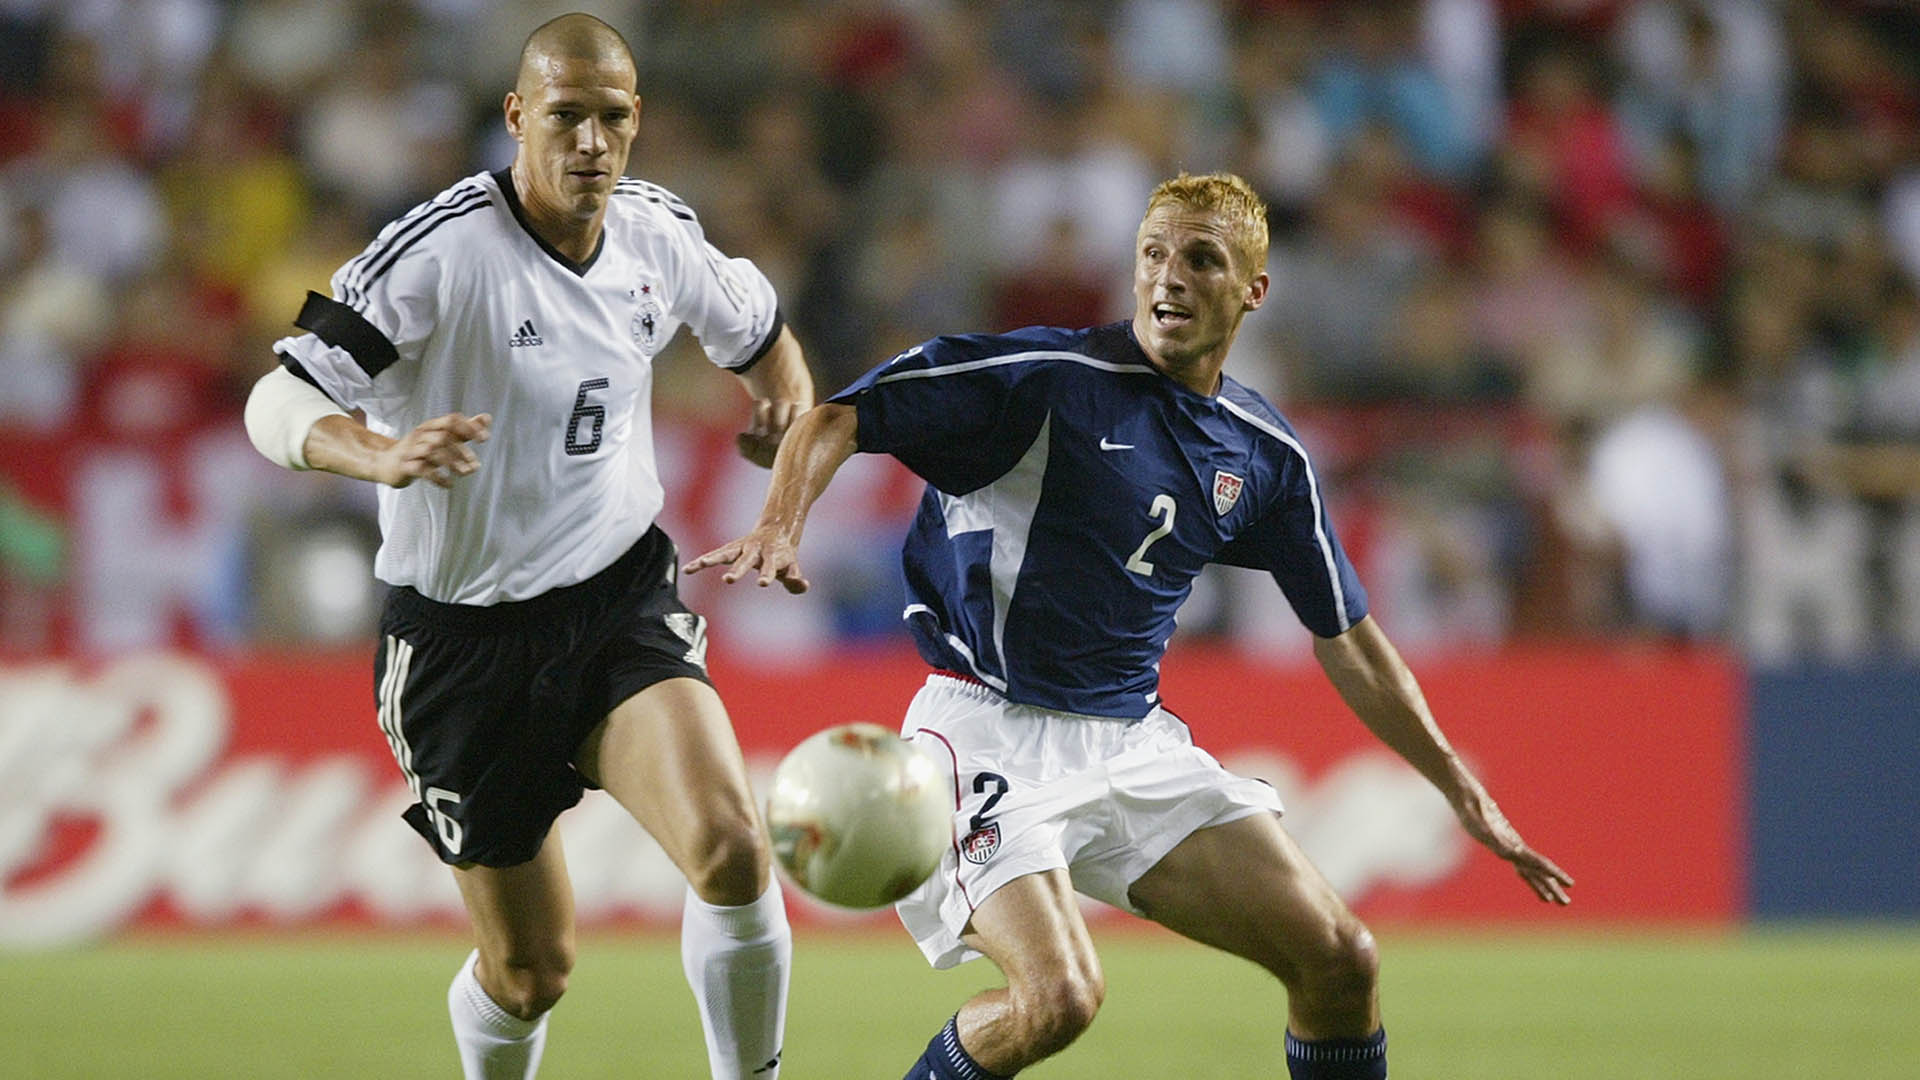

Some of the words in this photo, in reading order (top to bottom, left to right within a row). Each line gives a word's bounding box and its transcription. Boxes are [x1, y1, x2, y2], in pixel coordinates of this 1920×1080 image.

[509, 337, 543, 348] adidas
[565, 378, 609, 456] 6
[1125, 494, 1176, 577] 2
[426, 787, 463, 855] 6
[970, 772, 1008, 831] 2
